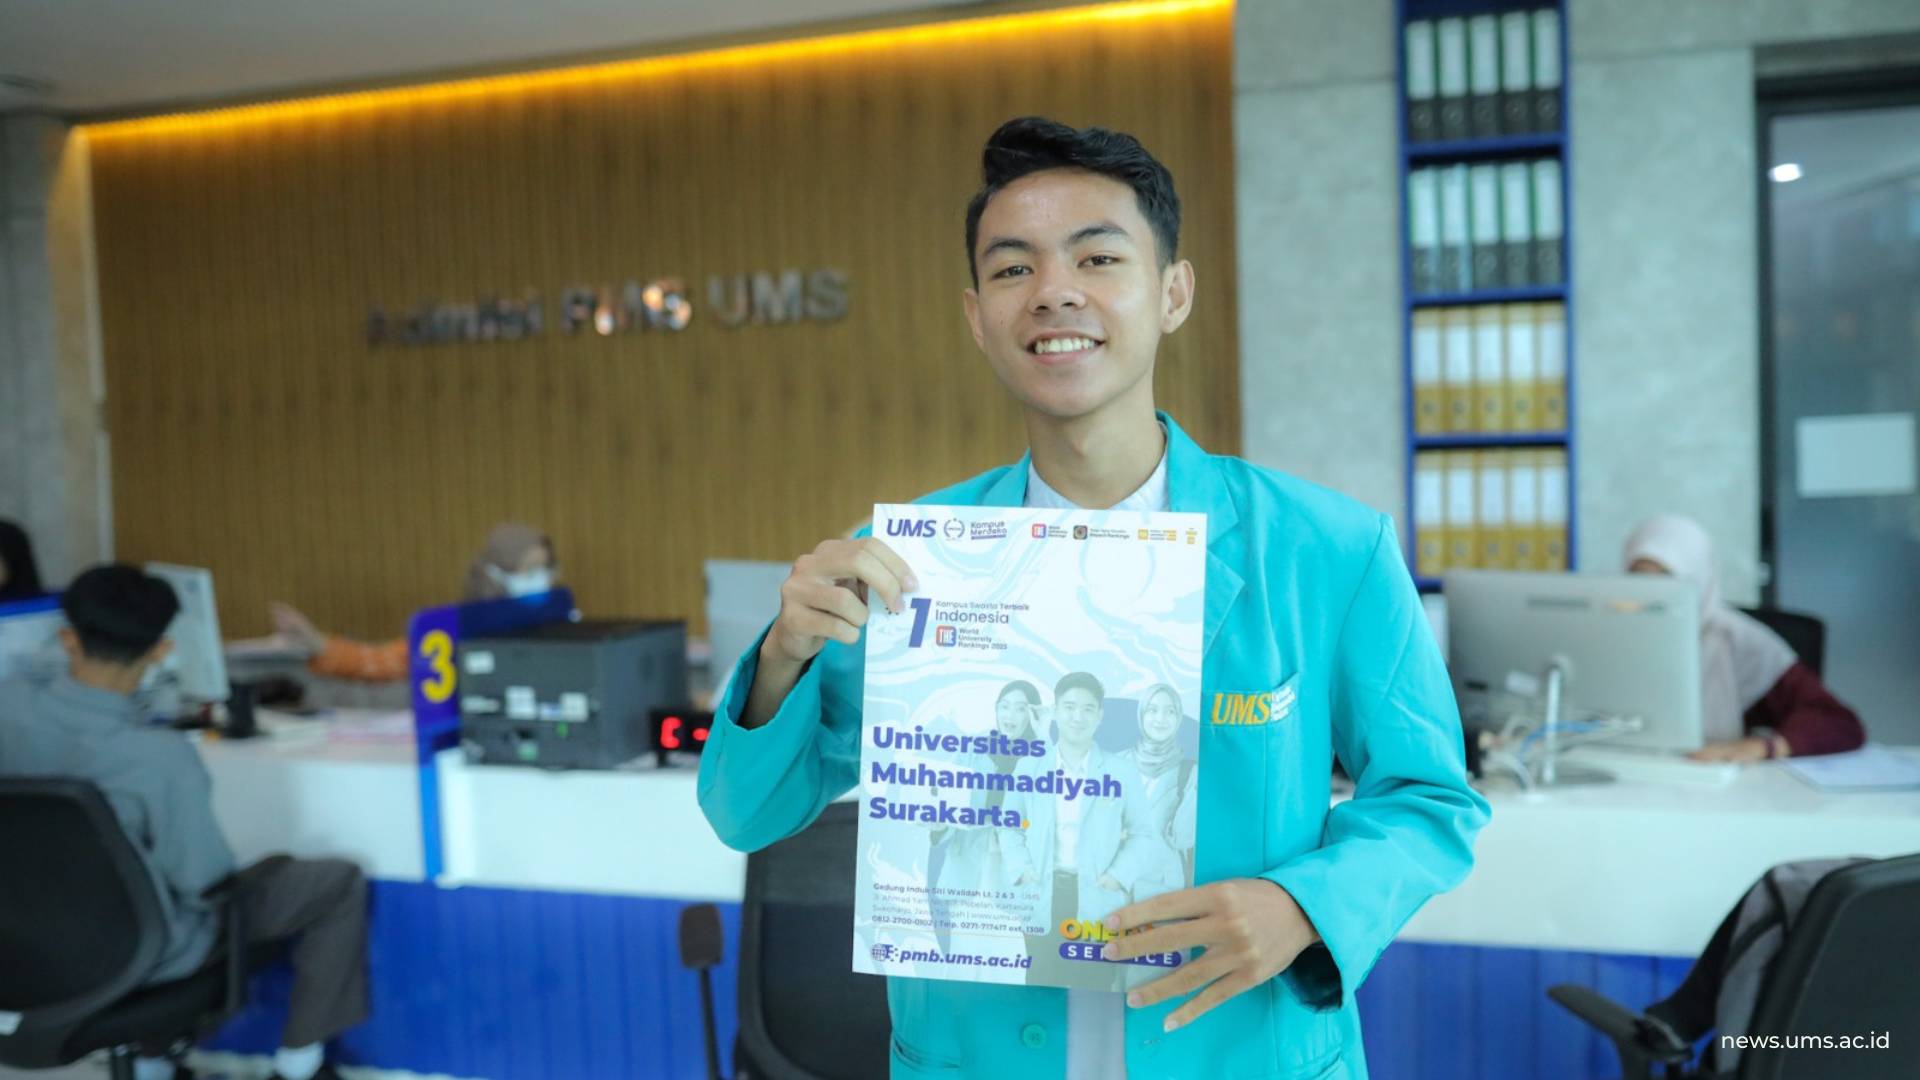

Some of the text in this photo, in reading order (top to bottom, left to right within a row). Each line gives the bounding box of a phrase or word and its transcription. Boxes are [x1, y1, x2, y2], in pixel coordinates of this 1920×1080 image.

[707, 270, 849, 329] UMS
[886, 518, 937, 538] UMS
[908, 598, 932, 648] 1
[935, 610, 1009, 624] Indonesia
[420, 629, 457, 703] 3
[1212, 693, 1272, 725] UMS
[872, 726, 1046, 758] Universitas
[871, 761, 1122, 801] Muhammadiyah
[869, 797, 1030, 829] Surakarta.
[899, 949, 1033, 969] pmb.ums.ac.id
